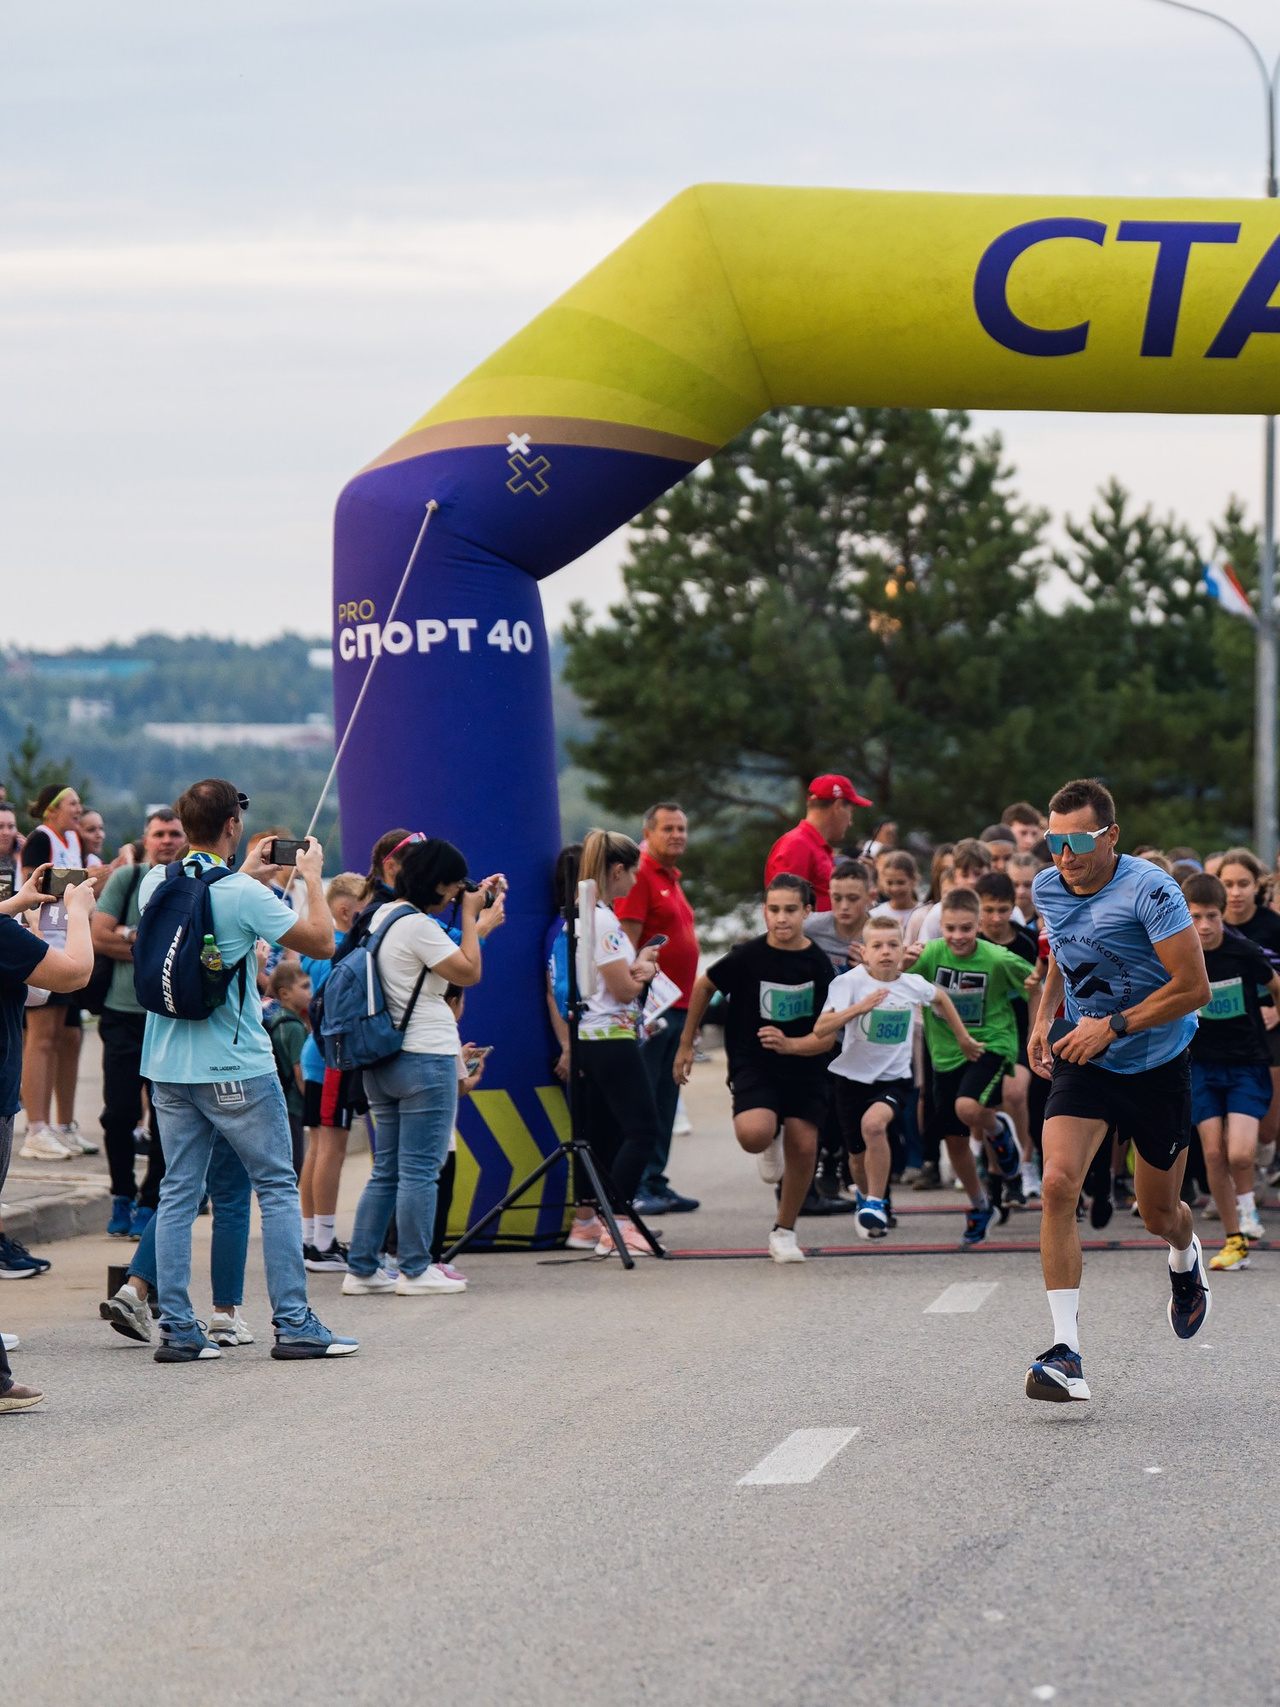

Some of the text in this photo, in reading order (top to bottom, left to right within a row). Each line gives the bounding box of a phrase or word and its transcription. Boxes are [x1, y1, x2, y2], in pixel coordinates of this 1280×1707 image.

[338, 599, 376, 624] PRO
[339, 618, 534, 662] СПОРТ 40
[1079, 935, 1125, 971] ЛЕГКОВА
[161, 925, 184, 1015] SKECHERS
[777, 998, 808, 1018] 2101
[875, 1022, 907, 1039] 3647
